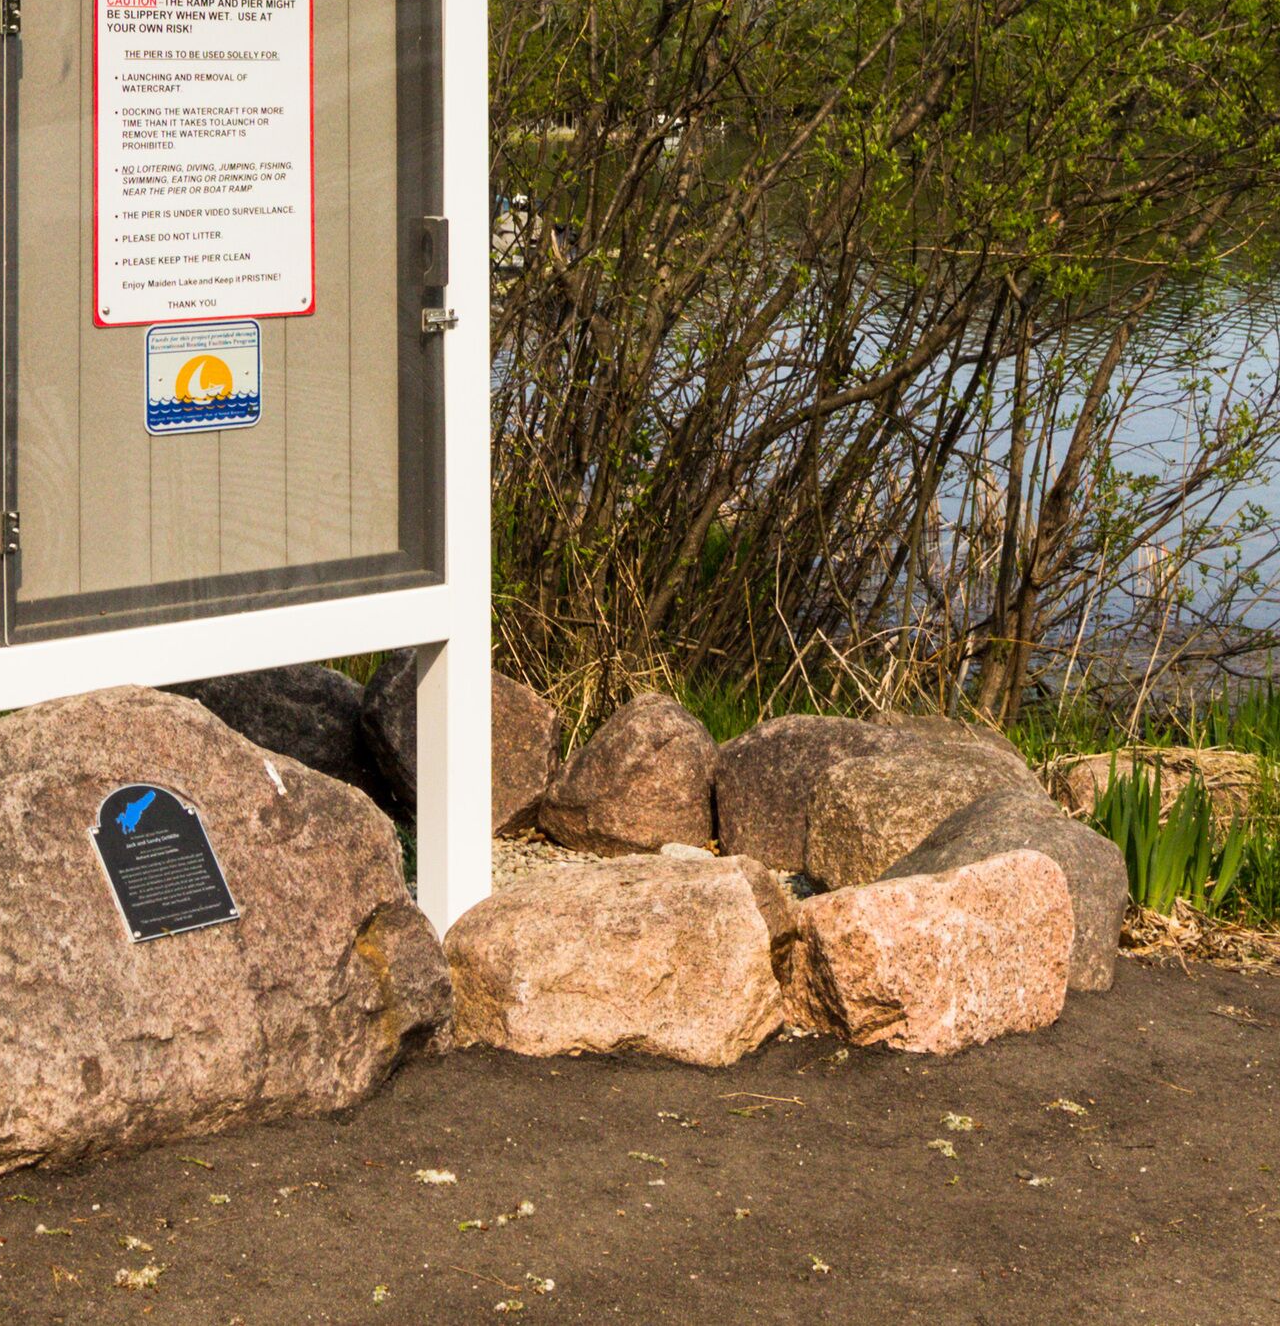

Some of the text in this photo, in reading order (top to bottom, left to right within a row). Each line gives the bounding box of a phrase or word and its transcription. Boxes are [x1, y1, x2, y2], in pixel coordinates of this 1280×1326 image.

[265, 0, 296, 9] MIGHT
[106, 9, 120, 19] BE
[123, 9, 173, 20] SLIPPERY
[175, 11, 206, 21] WHEN
[237, 12, 257, 22] USE
[259, 12, 273, 21] AT
[106, 22, 193, 34] YOUR OWN RISK!
[122, 73, 247, 82] LAUNCHING AND REMOVAL OF
[122, 106, 284, 116] DOCKING THE WATERCRAFT FOR MORE
[121, 129, 246, 139] REMOVE THE WATERCRAFT IS
[121, 161, 293, 175] NO LOITERING, DIVING, JUMPING, FISHING,
[122, 211, 139, 220] THE
[141, 210, 161, 219] PIER
[163, 209, 171, 218] IS
[173, 208, 203, 218] UNDER
[204, 207, 230, 217] VIDEO
[122, 252, 251, 267] PLEASE KEEP THE PIER CLEAN
[122, 273, 281, 291] Enjoy Maiden Lake and Keep it PRISTINE!
[168, 298, 217, 309] THANK YOU
